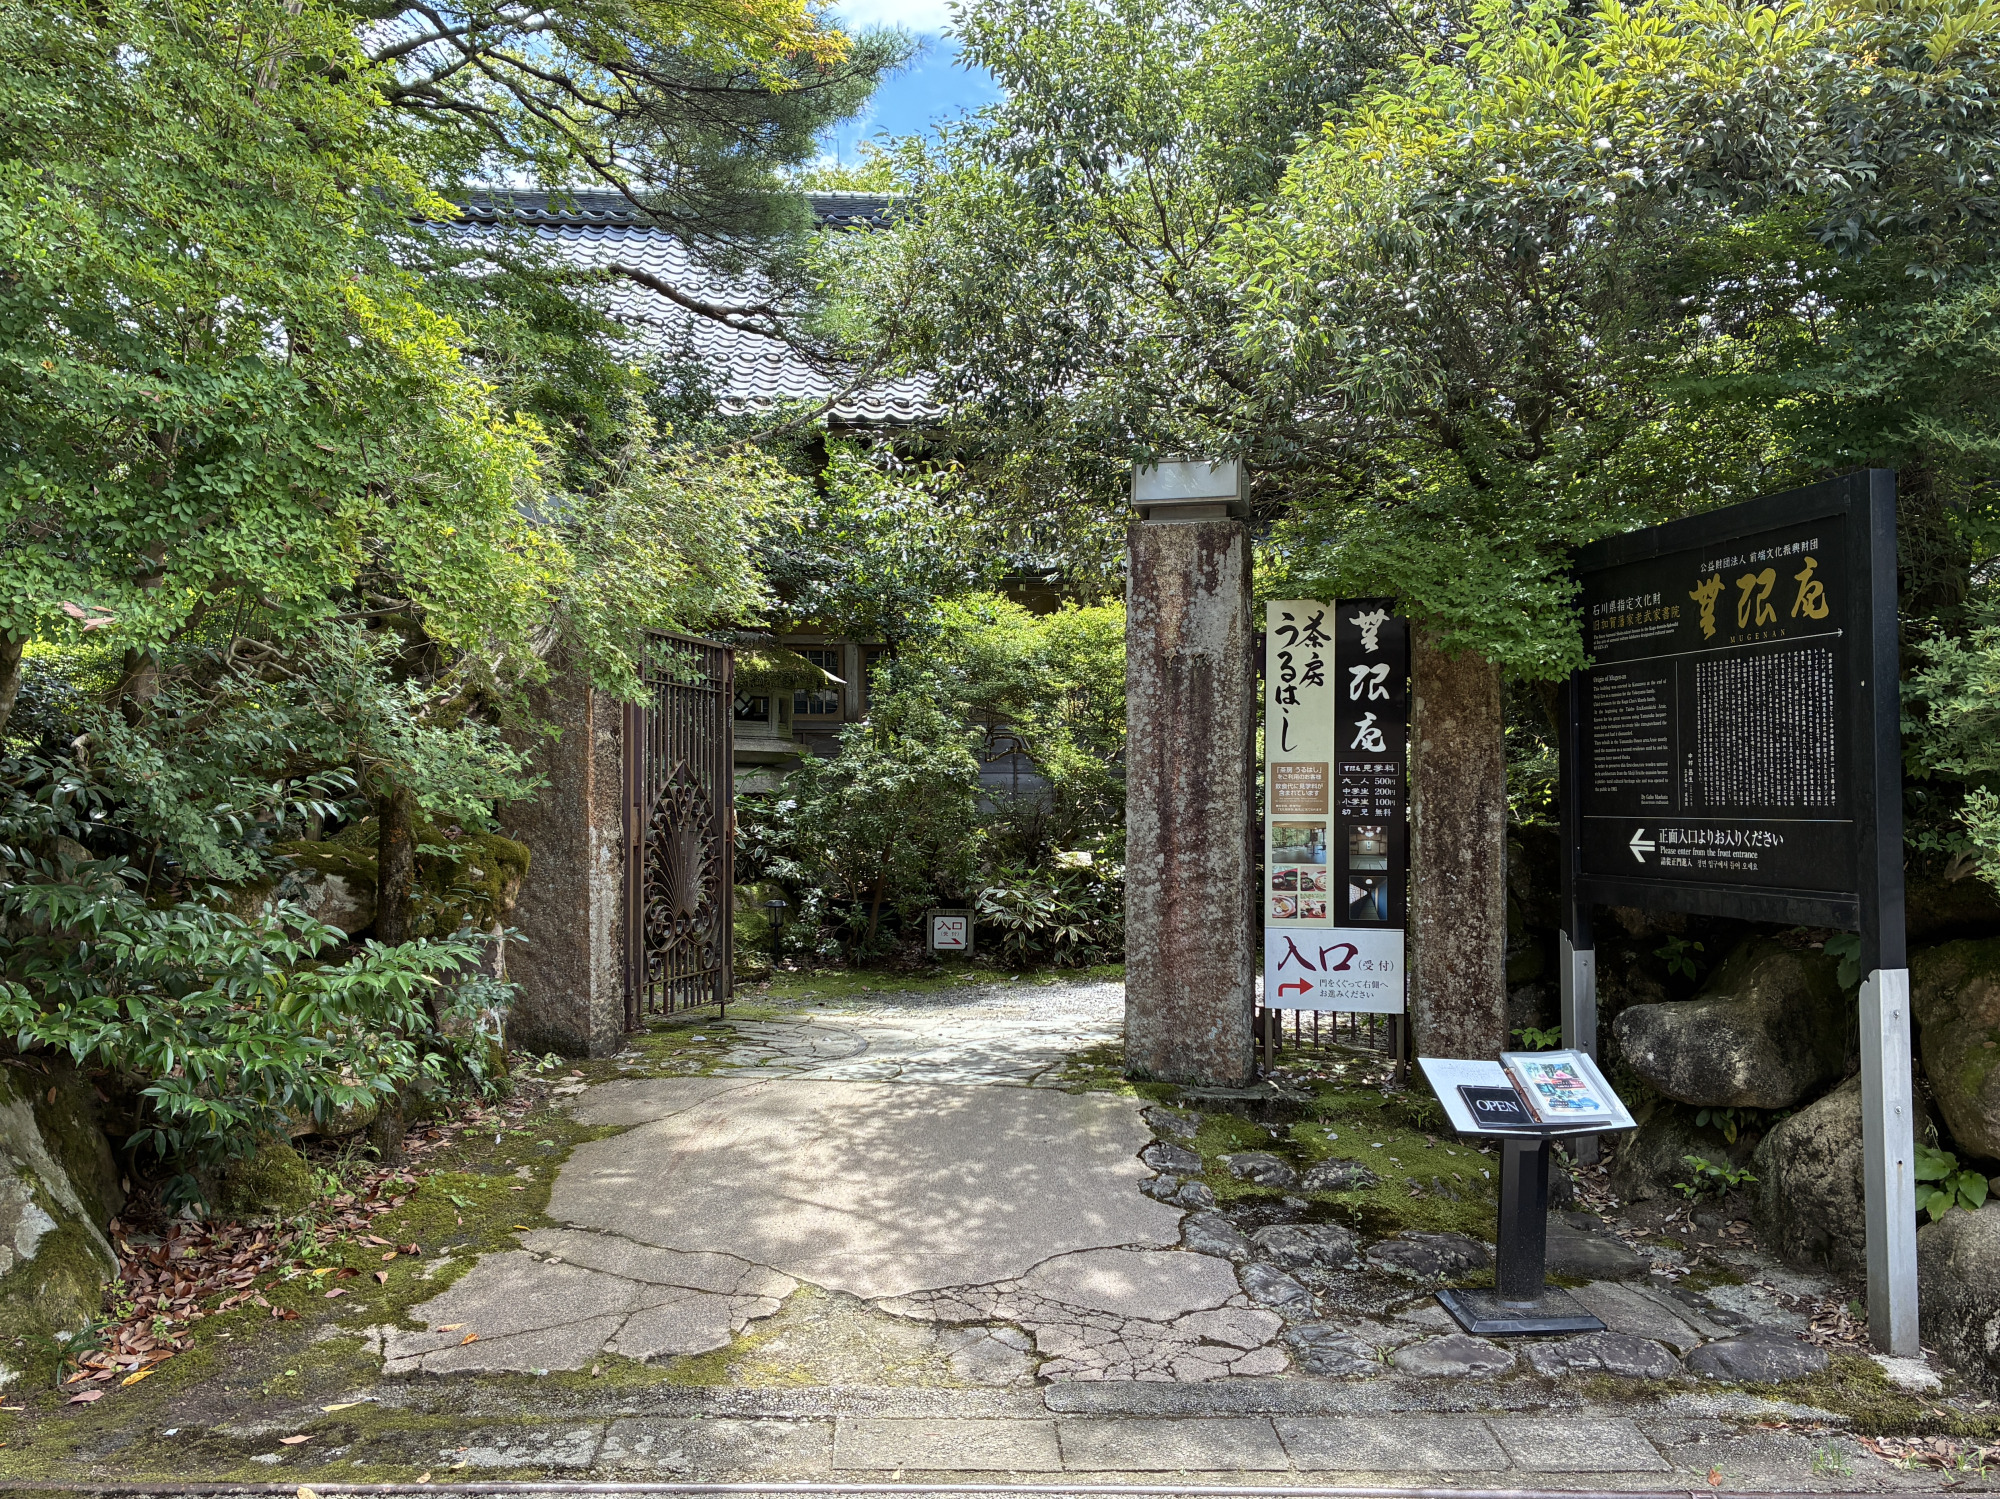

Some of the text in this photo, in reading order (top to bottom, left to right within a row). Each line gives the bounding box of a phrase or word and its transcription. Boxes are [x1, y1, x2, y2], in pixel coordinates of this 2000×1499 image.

[1700, 554, 1746, 573] 公益財団法人
[1592, 592, 1661, 616] 石川県指定文化財
[1295, 609, 1332, 688] 茶房
[1274, 612, 1300, 753] うるはし
[1374, 777, 1396, 785] 500円
[1374, 788, 1396, 796] 200円
[1374, 798, 1396, 806] 100円
[1659, 828, 1784, 848] 正面入口よりお入りください
[1660, 845, 1758, 859] Please enter from the front entrance
[937, 920, 962, 930] 入口
[1277, 935, 1358, 972] 入口
[1319, 978, 1389, 989] 門をくぐって右側へ
[1319, 989, 1374, 999] お進みください
[1476, 1099, 1519, 1113] OPEN
